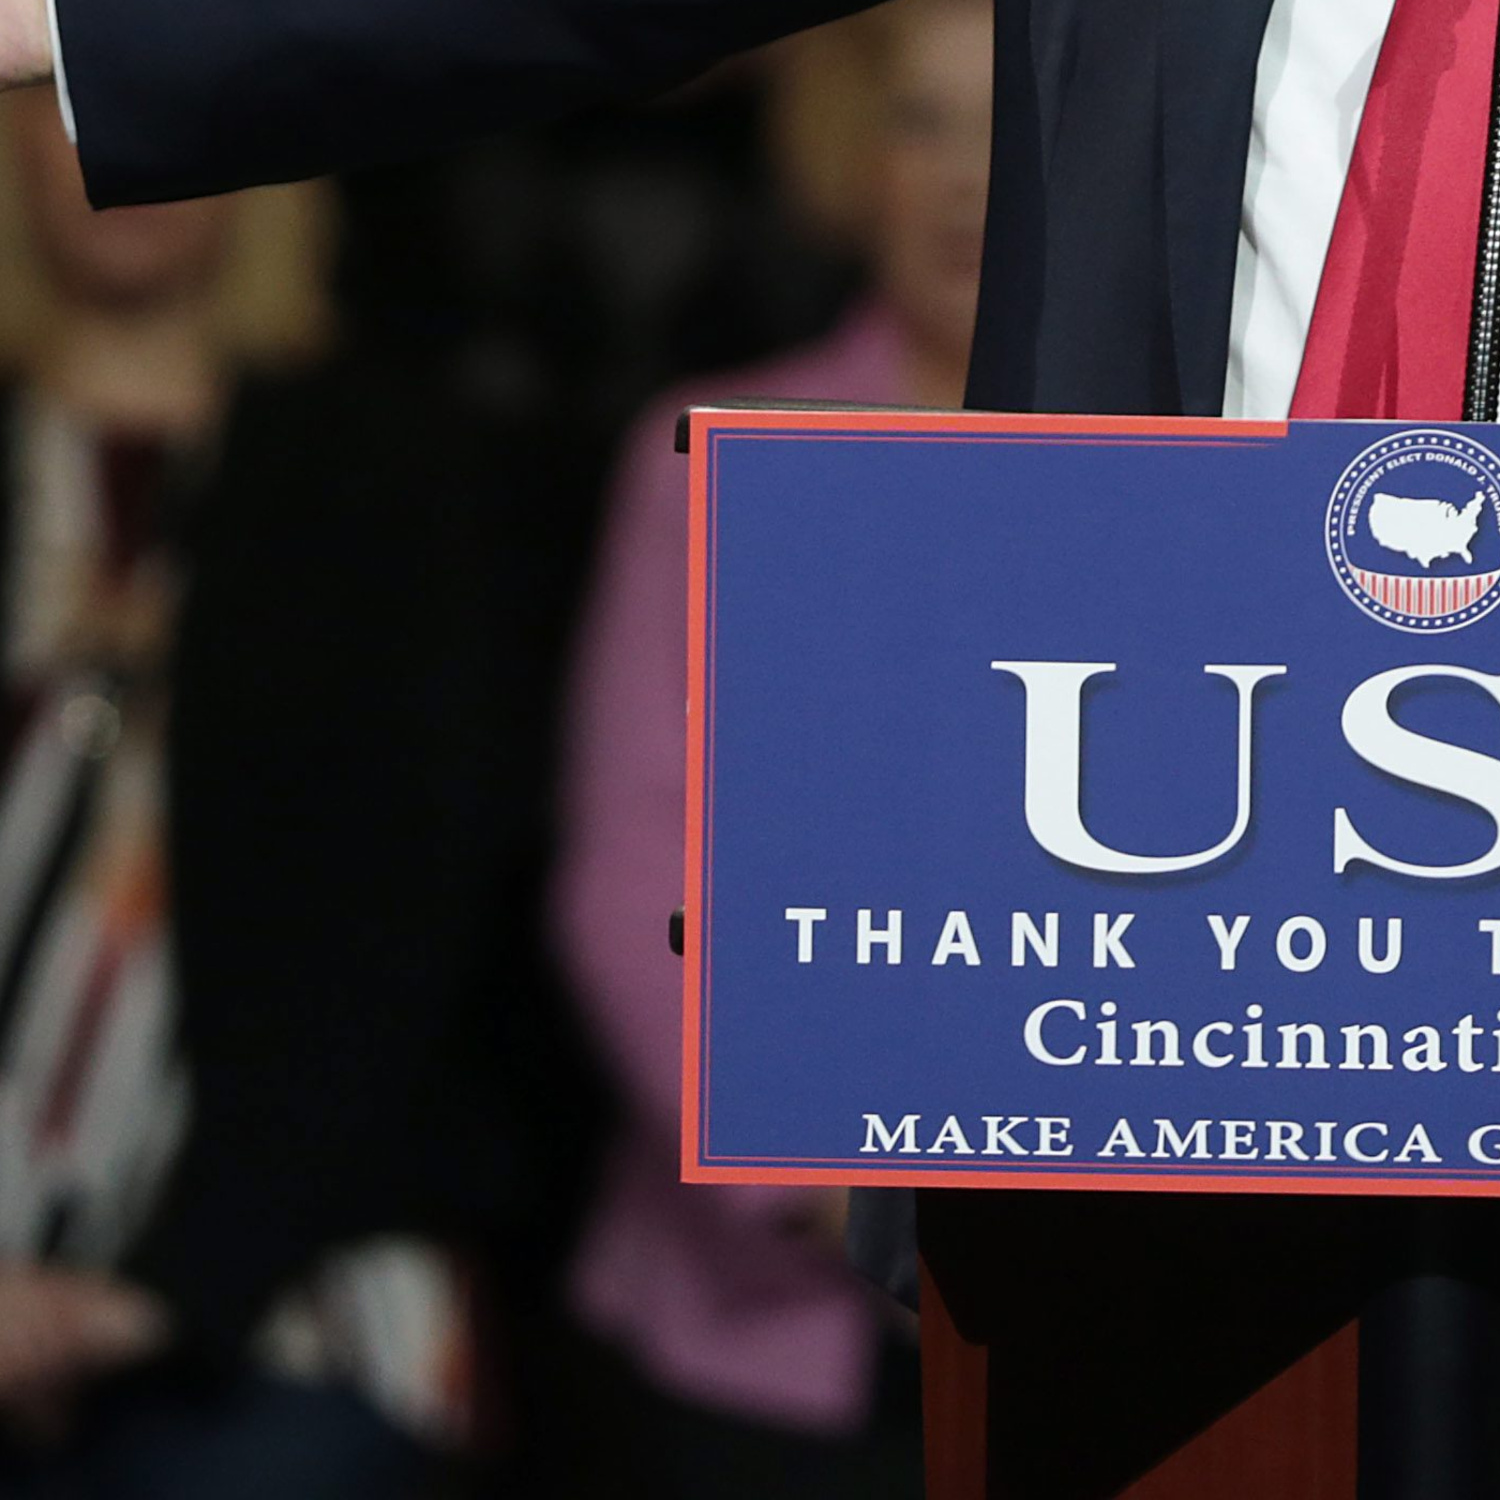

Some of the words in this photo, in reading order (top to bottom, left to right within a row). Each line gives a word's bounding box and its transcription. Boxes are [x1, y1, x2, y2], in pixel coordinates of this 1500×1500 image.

[1346, 465, 1386, 536] PRESIDENT
[1386, 451, 1423, 470] ELECT
[1424, 451, 1478, 476] DONALD
[785, 907, 1137, 969] THANK
[1207, 915, 1403, 974] YOU
[859, 1114, 1074, 1156] MAKE
[1097, 1118, 1444, 1163] AMERICA
